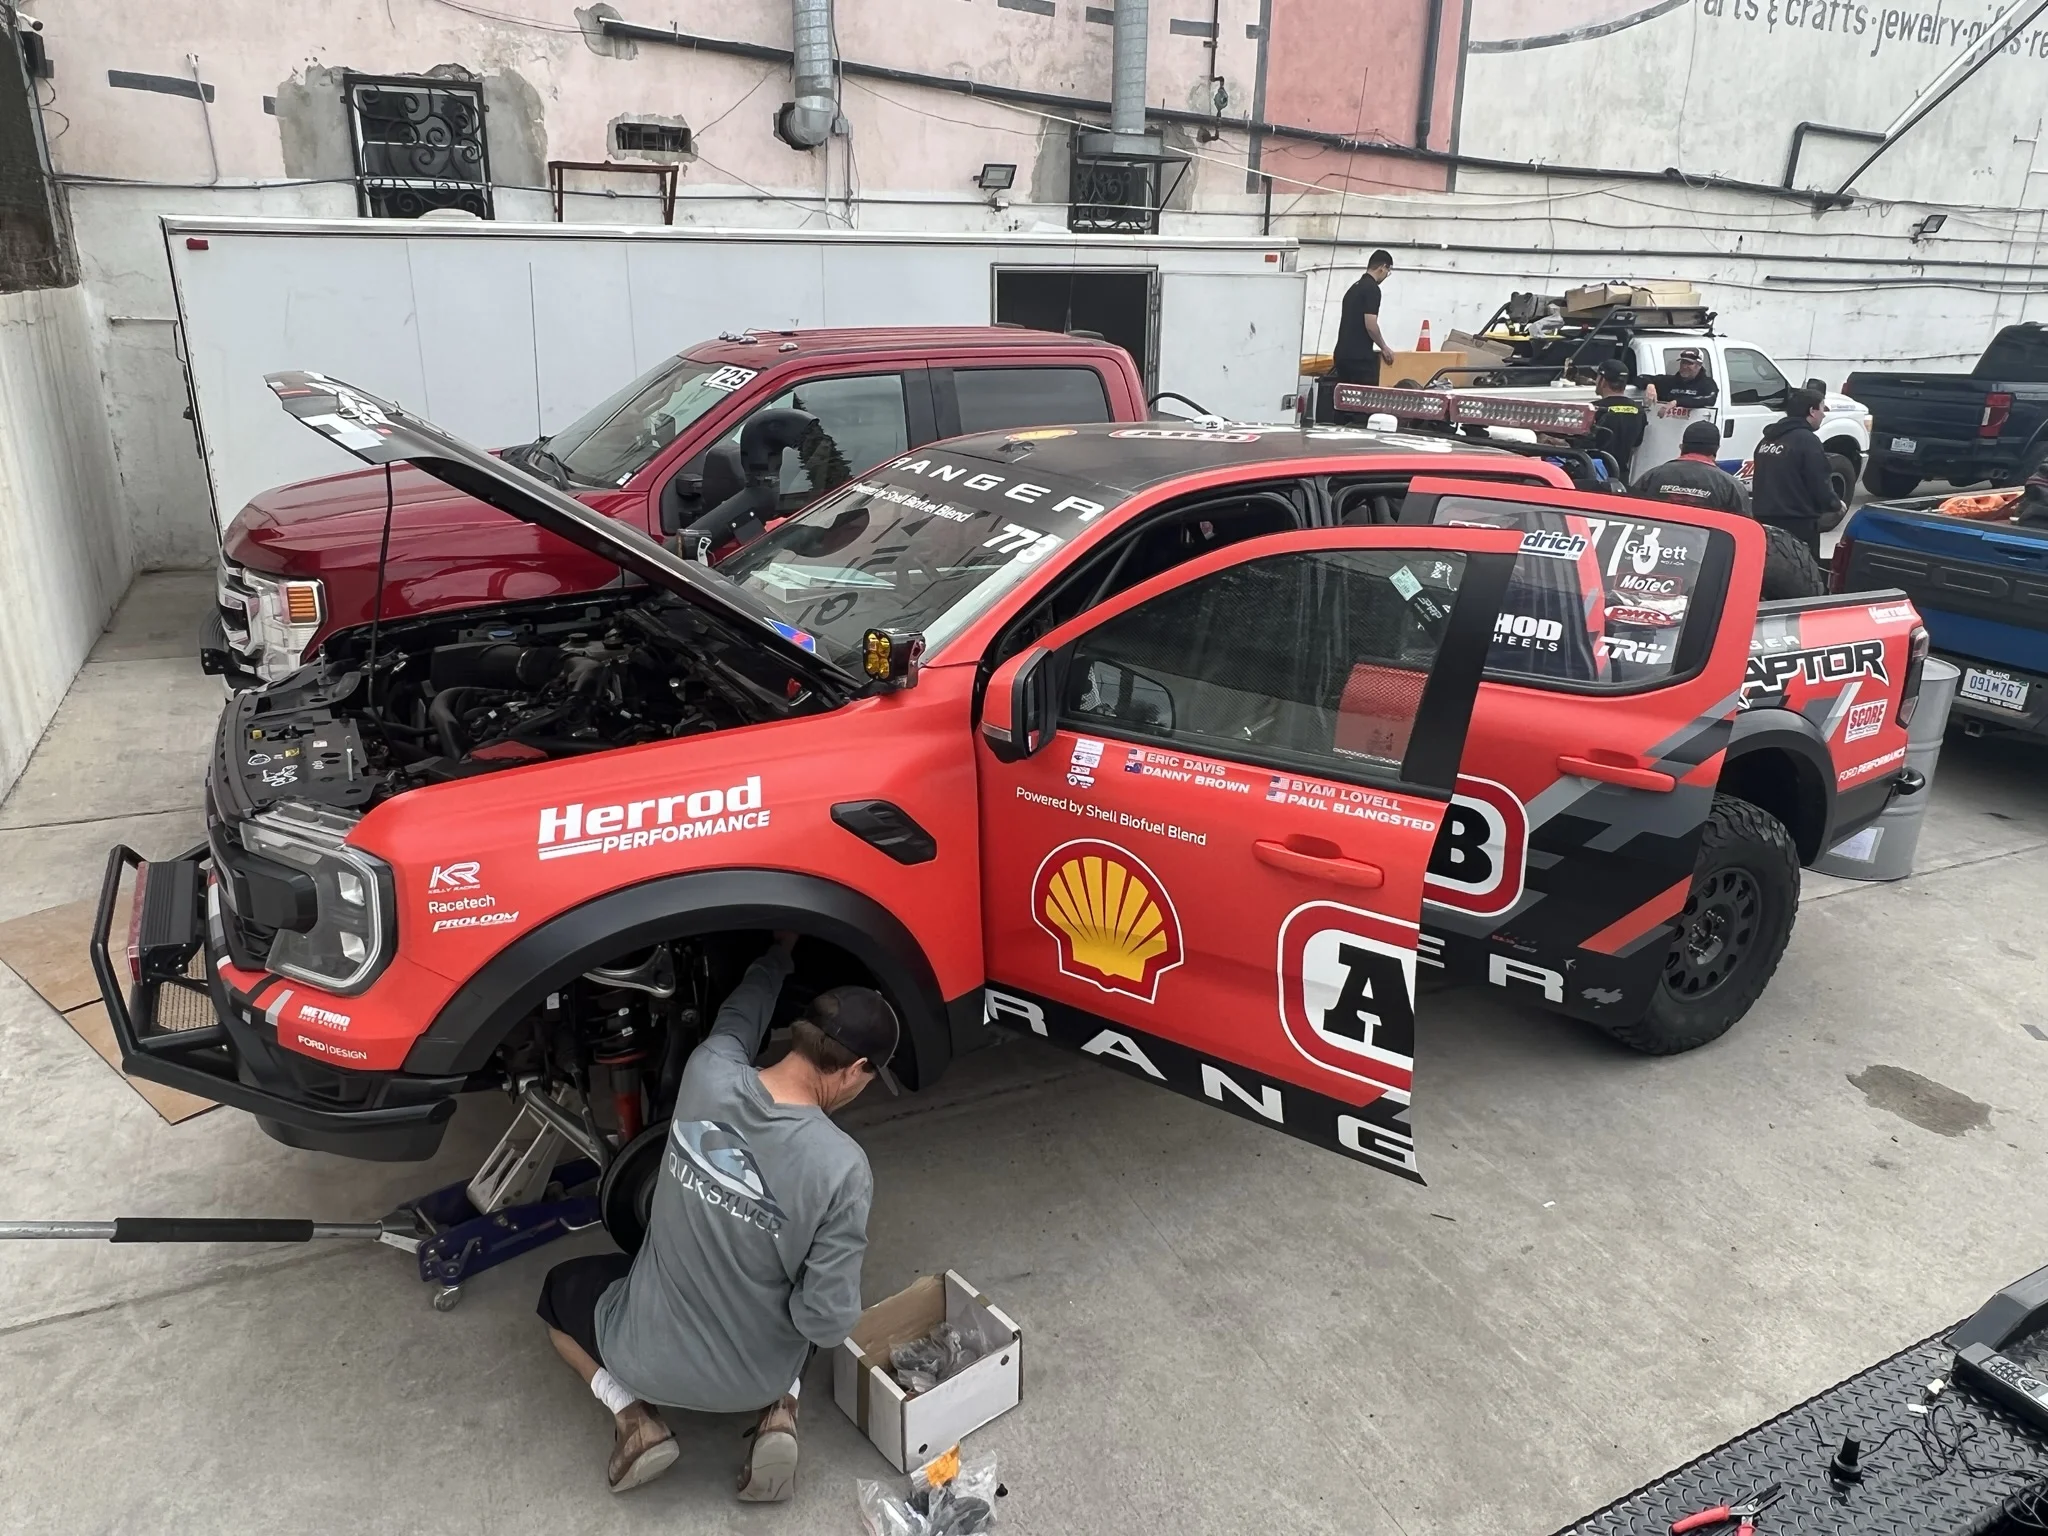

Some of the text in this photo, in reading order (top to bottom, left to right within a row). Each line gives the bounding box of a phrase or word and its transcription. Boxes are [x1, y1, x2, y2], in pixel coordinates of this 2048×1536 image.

[1785, 0, 1868, 35] crafts
[1870, 8, 1964, 58] jewelry
[710, 368, 753, 387] 725
[883, 456, 1105, 522] RANGER
[932, 503, 974, 523] Blend
[1522, 530, 1587, 553] drich
[1624, 539, 1688, 562] Gaett
[1620, 575, 1675, 594] MoTeC
[1597, 635, 1668, 665] TRW
[1850, 703, 1885, 730] SCORE
[1146, 753, 1226, 776] ERIC DAVIS
[1142, 765, 1250, 794] DANNY BROWN
[1291, 780, 1402, 811] BYAM LOVELL
[537, 775, 762, 845] Herrod
[1016, 787, 1207, 846] Powered by Shell Biofuel Blend
[1287, 794, 1435, 832] PAUL BLANGSTED
[602, 809, 771, 854] PERFORMANCE
[429, 861, 481, 889] KR
[428, 894, 496, 914] Racetech
[432, 911, 520, 933] PROLOOM
[300, 1005, 351, 1027] METHOD
[298, 1035, 367, 1060] FORD DESIGN
[668, 1151, 782, 1239] QUIKSILVER
